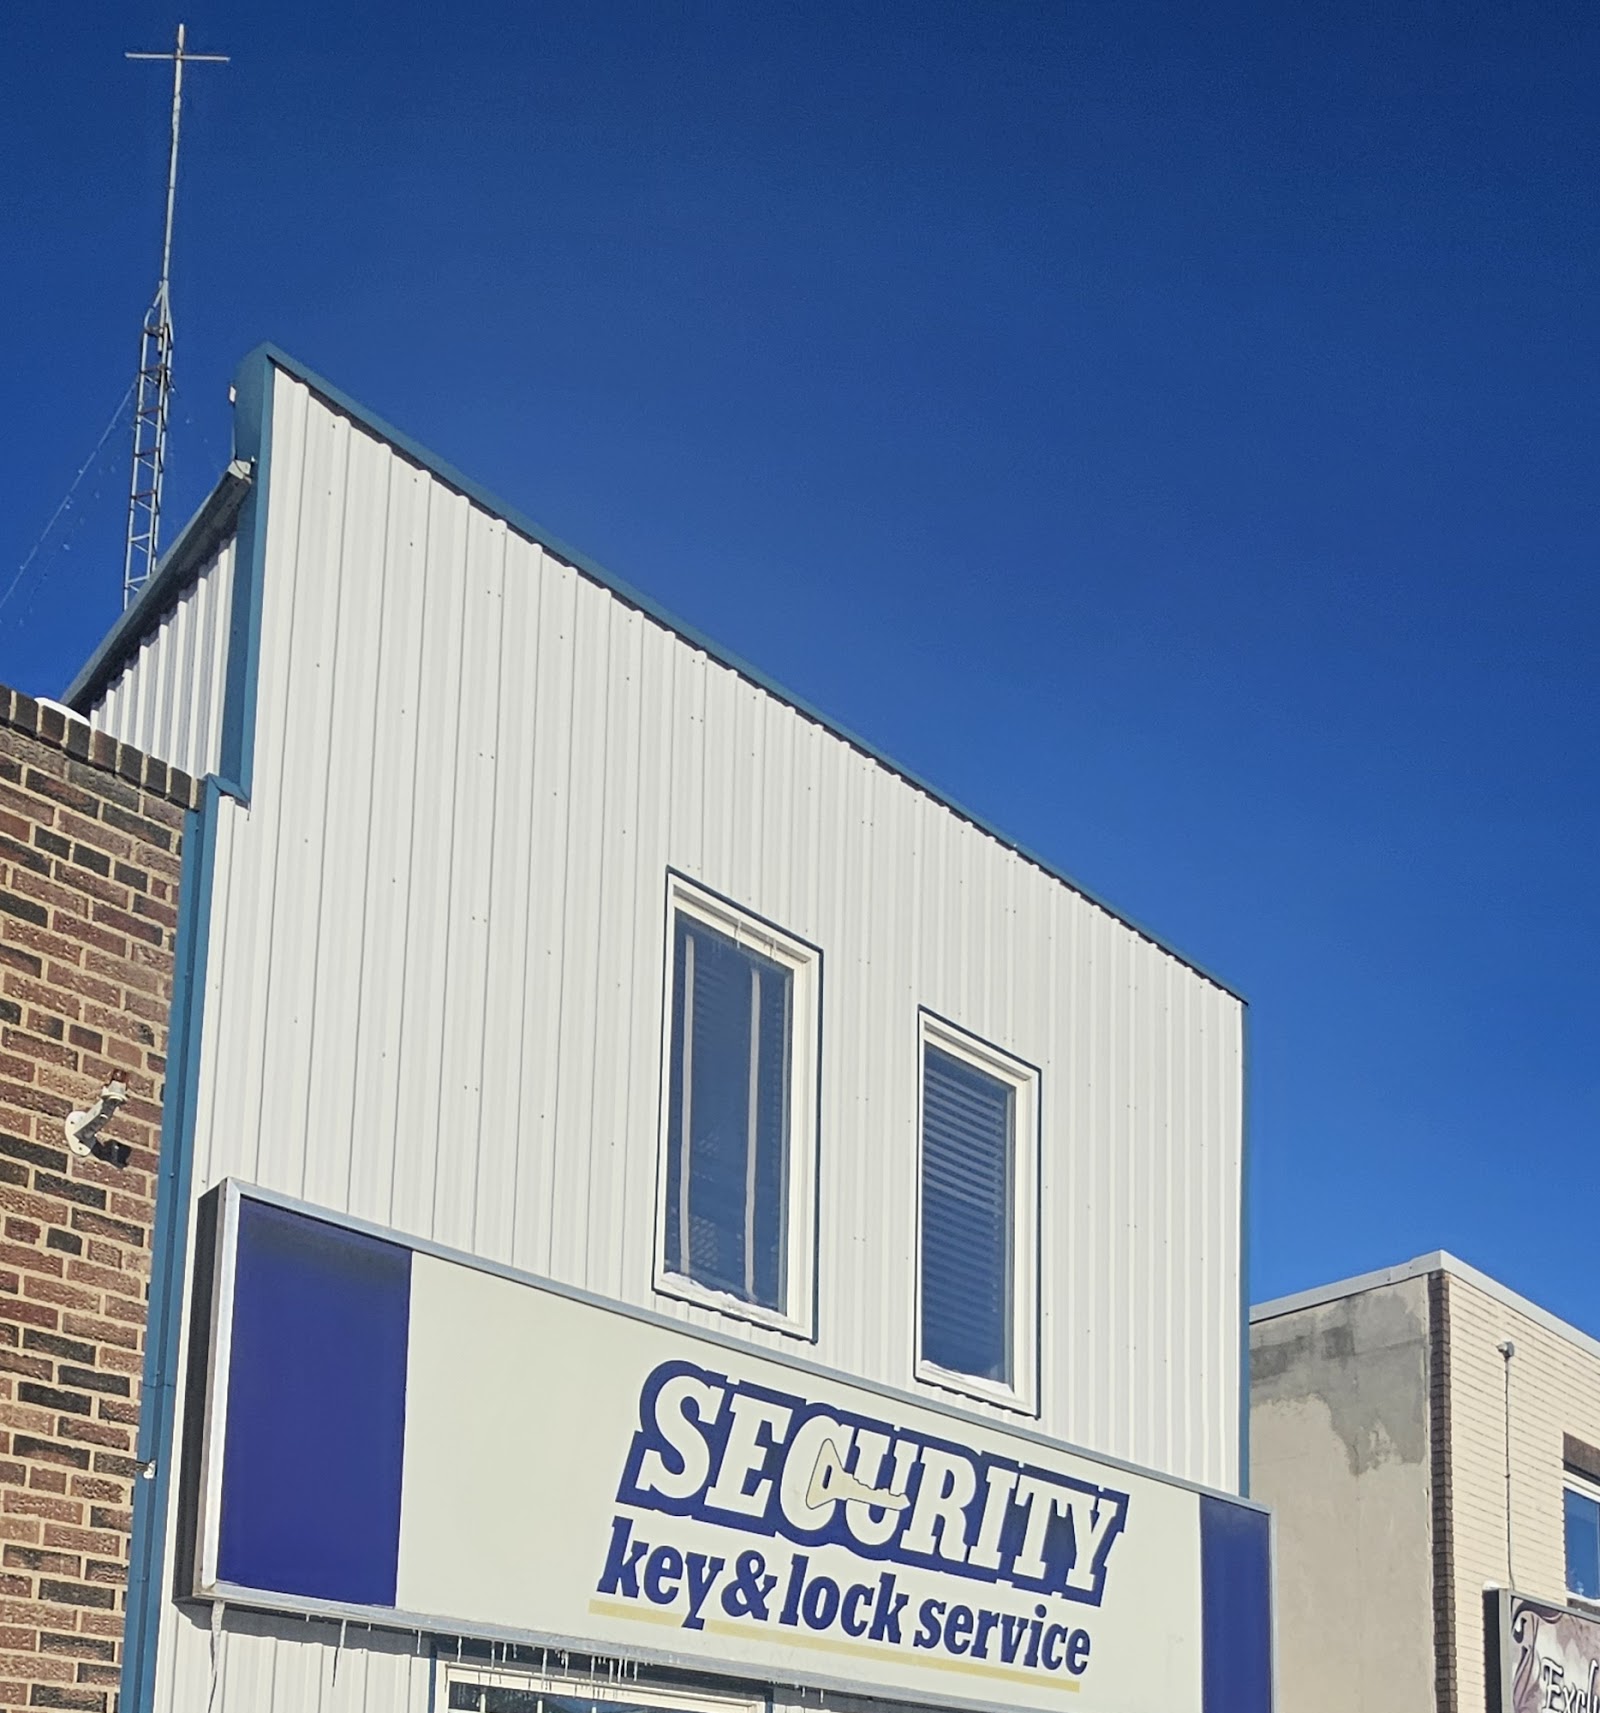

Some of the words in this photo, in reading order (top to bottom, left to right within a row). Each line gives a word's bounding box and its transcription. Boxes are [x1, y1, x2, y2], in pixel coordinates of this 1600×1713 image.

[615, 1360, 1129, 1606] SECURITY
[597, 1516, 724, 1631] key
[721, 1550, 777, 1621] &
[779, 1553, 909, 1643] lock
[913, 1598, 1091, 1675] service
